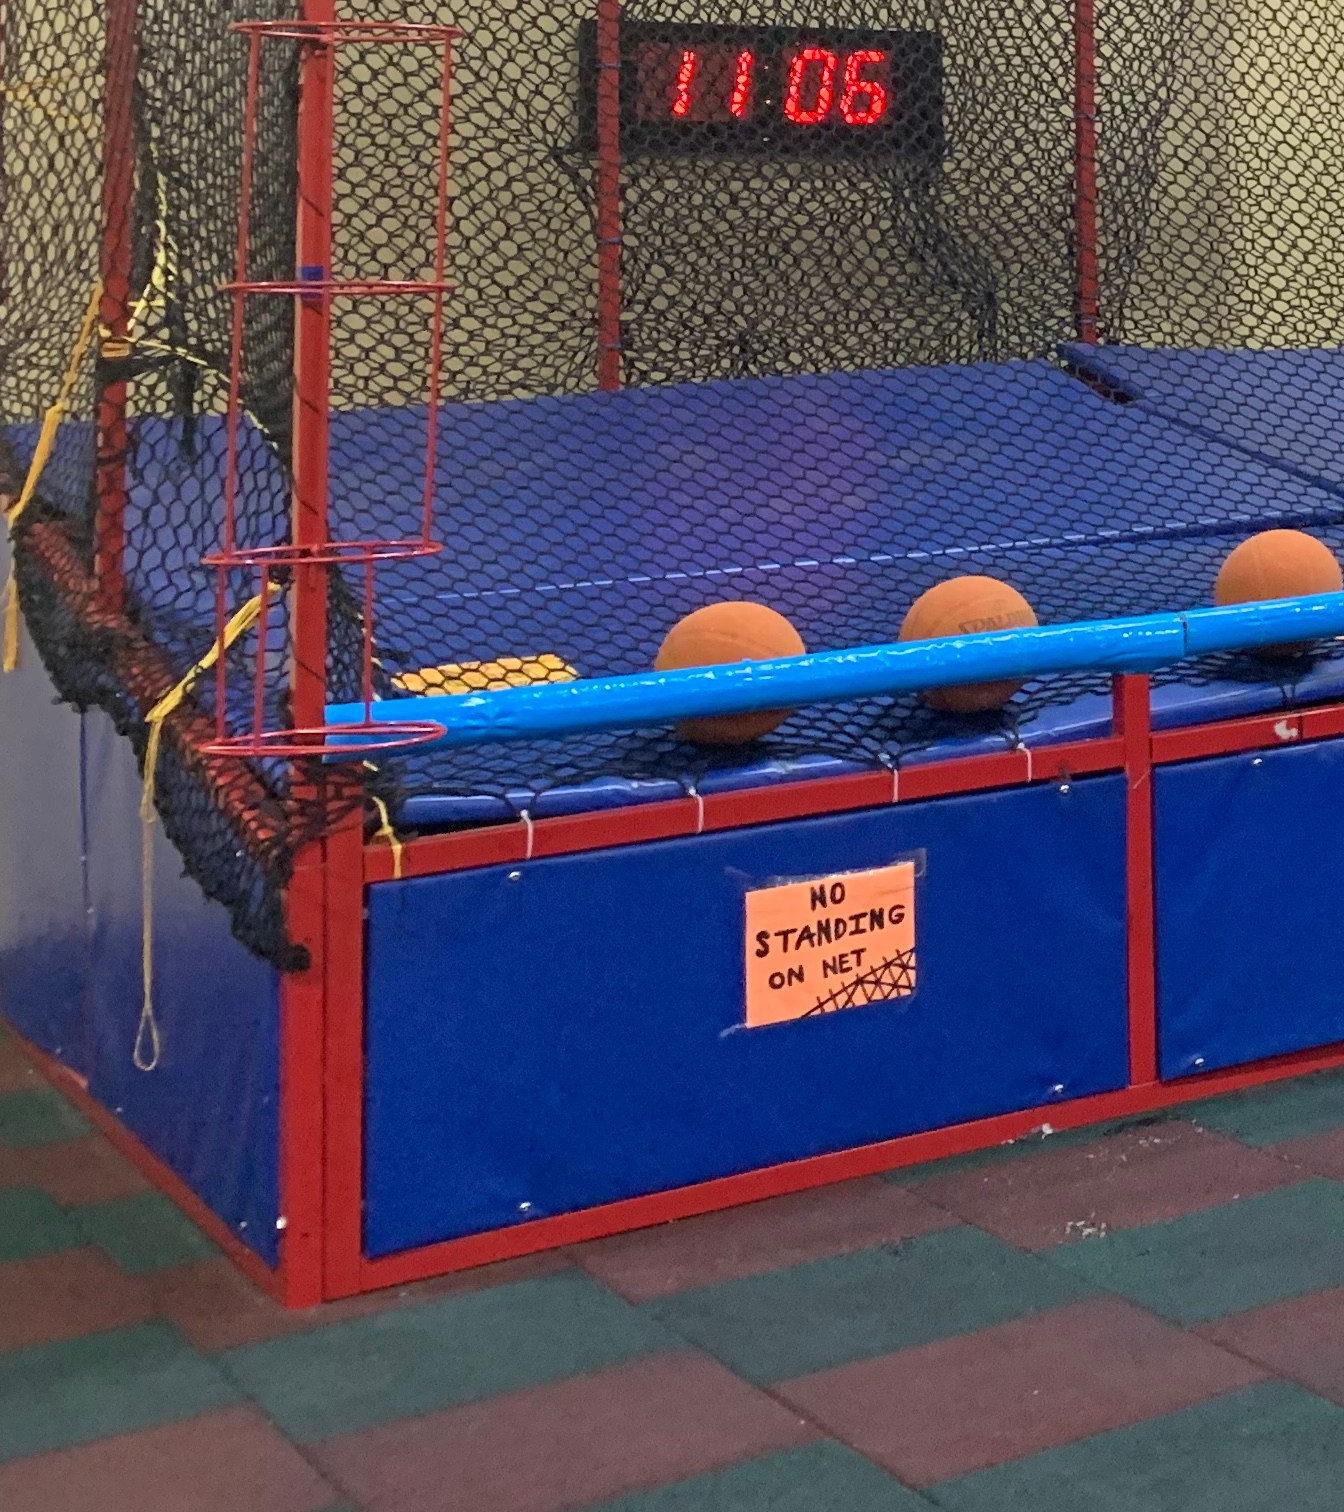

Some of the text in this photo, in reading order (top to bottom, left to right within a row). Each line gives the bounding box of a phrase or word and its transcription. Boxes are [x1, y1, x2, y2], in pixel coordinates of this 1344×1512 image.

[810, 882, 846, 911] NO
[755, 904, 906, 958] STANDING
[768, 947, 867, 990] ON NET
